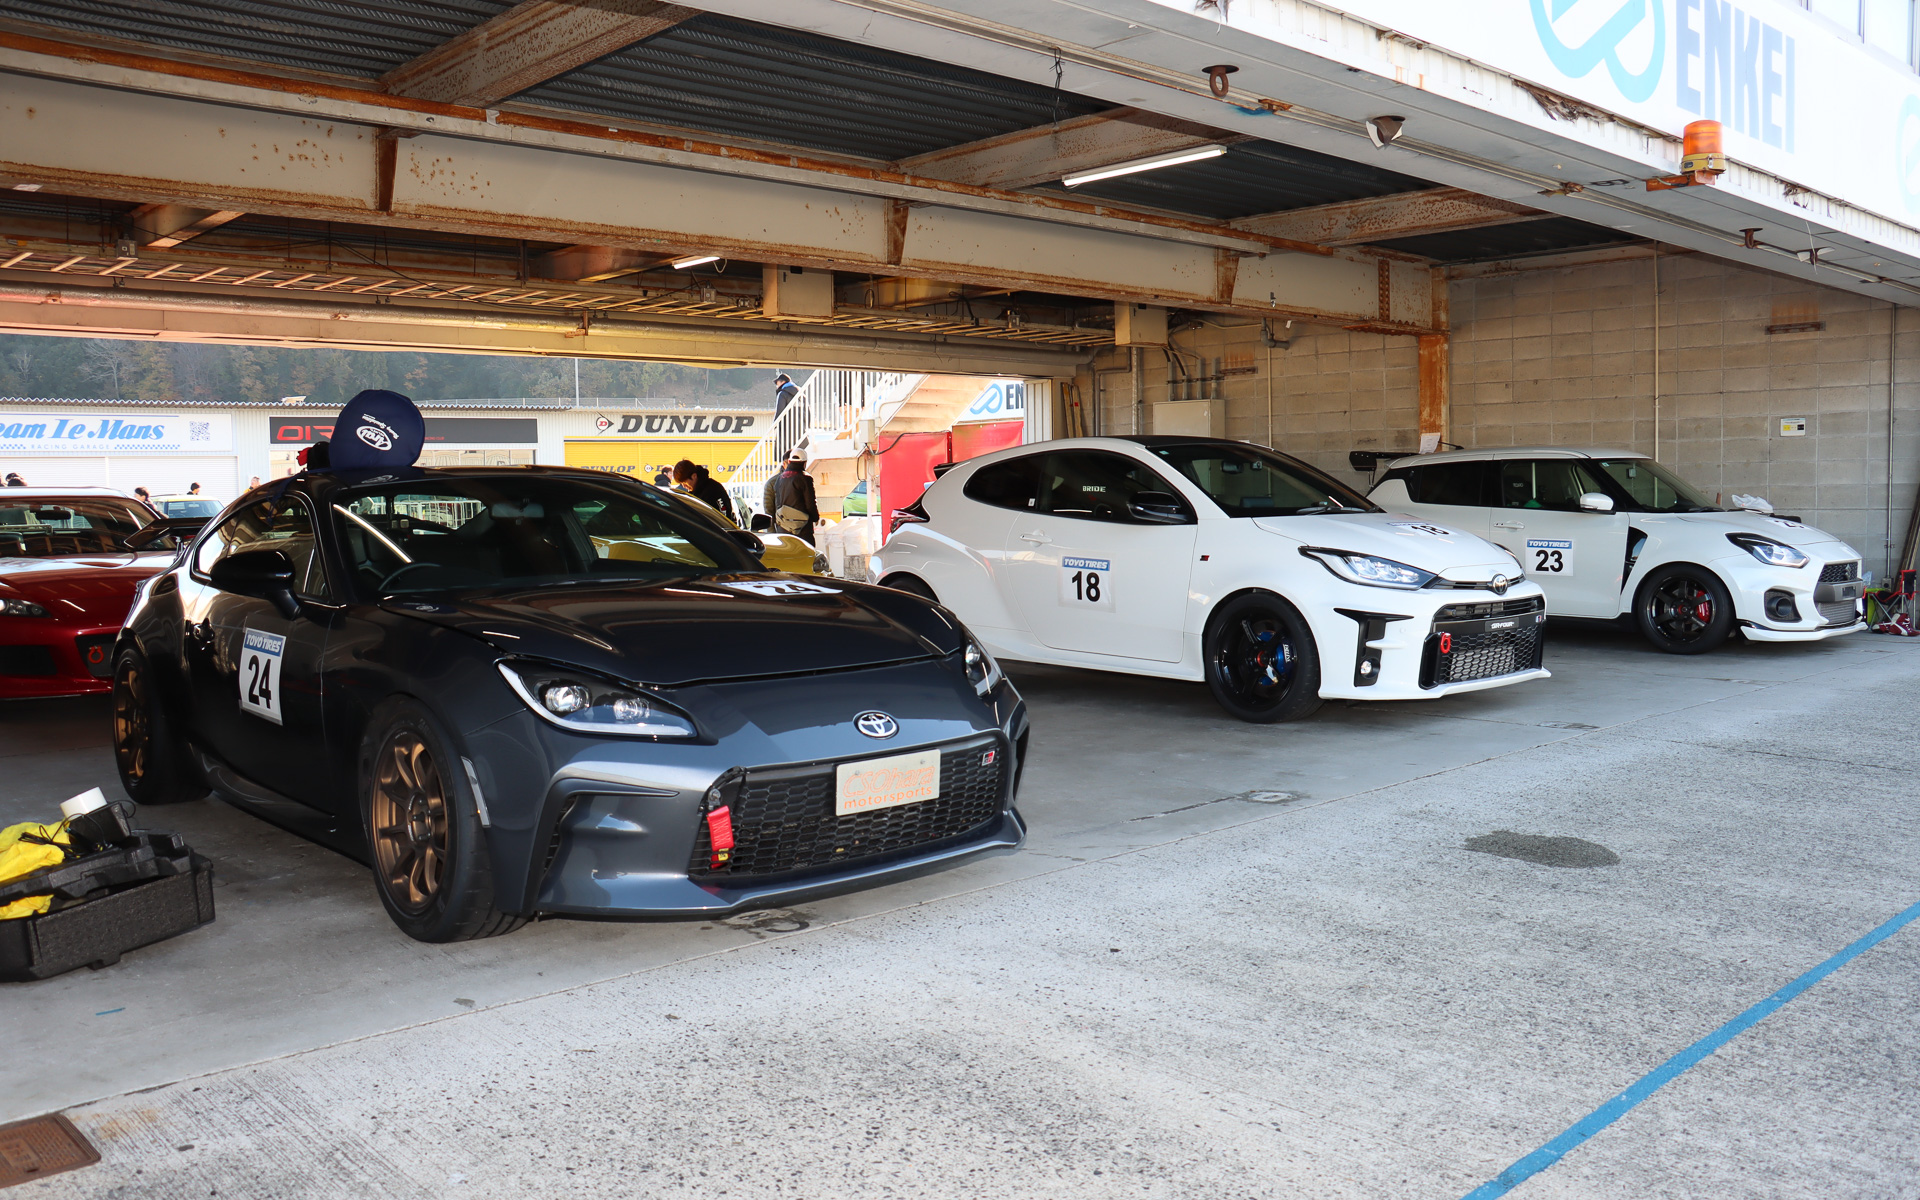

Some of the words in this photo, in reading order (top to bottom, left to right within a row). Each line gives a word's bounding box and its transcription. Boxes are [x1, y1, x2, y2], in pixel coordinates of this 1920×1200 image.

[1676, 0, 1795, 155] ENKEI
[48, 418, 86, 439] Le
[87, 419, 165, 440] Mans
[617, 415, 755, 433] DUNLOP
[1082, 485, 1106, 493] BRIDE
[1411, 525, 1449, 535] 18
[1064, 558, 1084, 567] TOYO
[1085, 560, 1108, 570] TIRES
[1535, 549, 1564, 573] 23
[1072, 571, 1101, 602] 18
[246, 634, 263, 649] TOYO
[262, 638, 281, 653] TIRES
[248, 655, 271, 709] 24
[844, 786, 932, 809] motorsports
